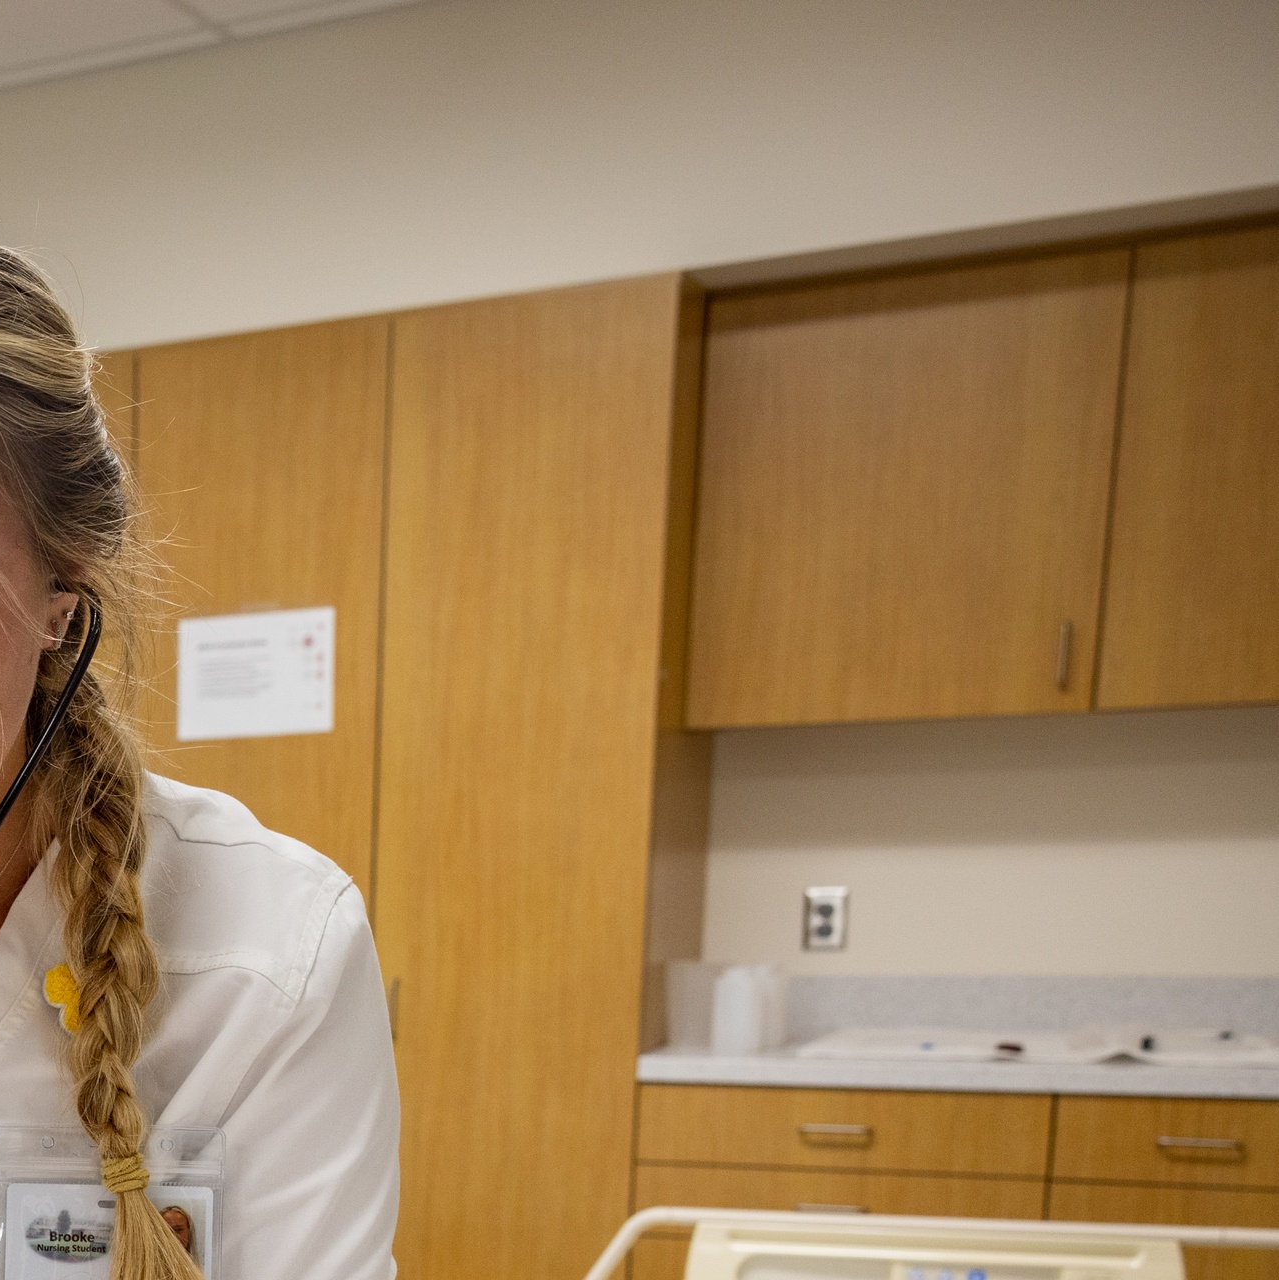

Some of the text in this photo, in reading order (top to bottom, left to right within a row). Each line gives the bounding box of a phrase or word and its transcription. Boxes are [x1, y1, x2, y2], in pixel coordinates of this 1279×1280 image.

[49, 1231, 95, 1243] Brooke
[37, 1244, 107, 1254] Nursing Student
